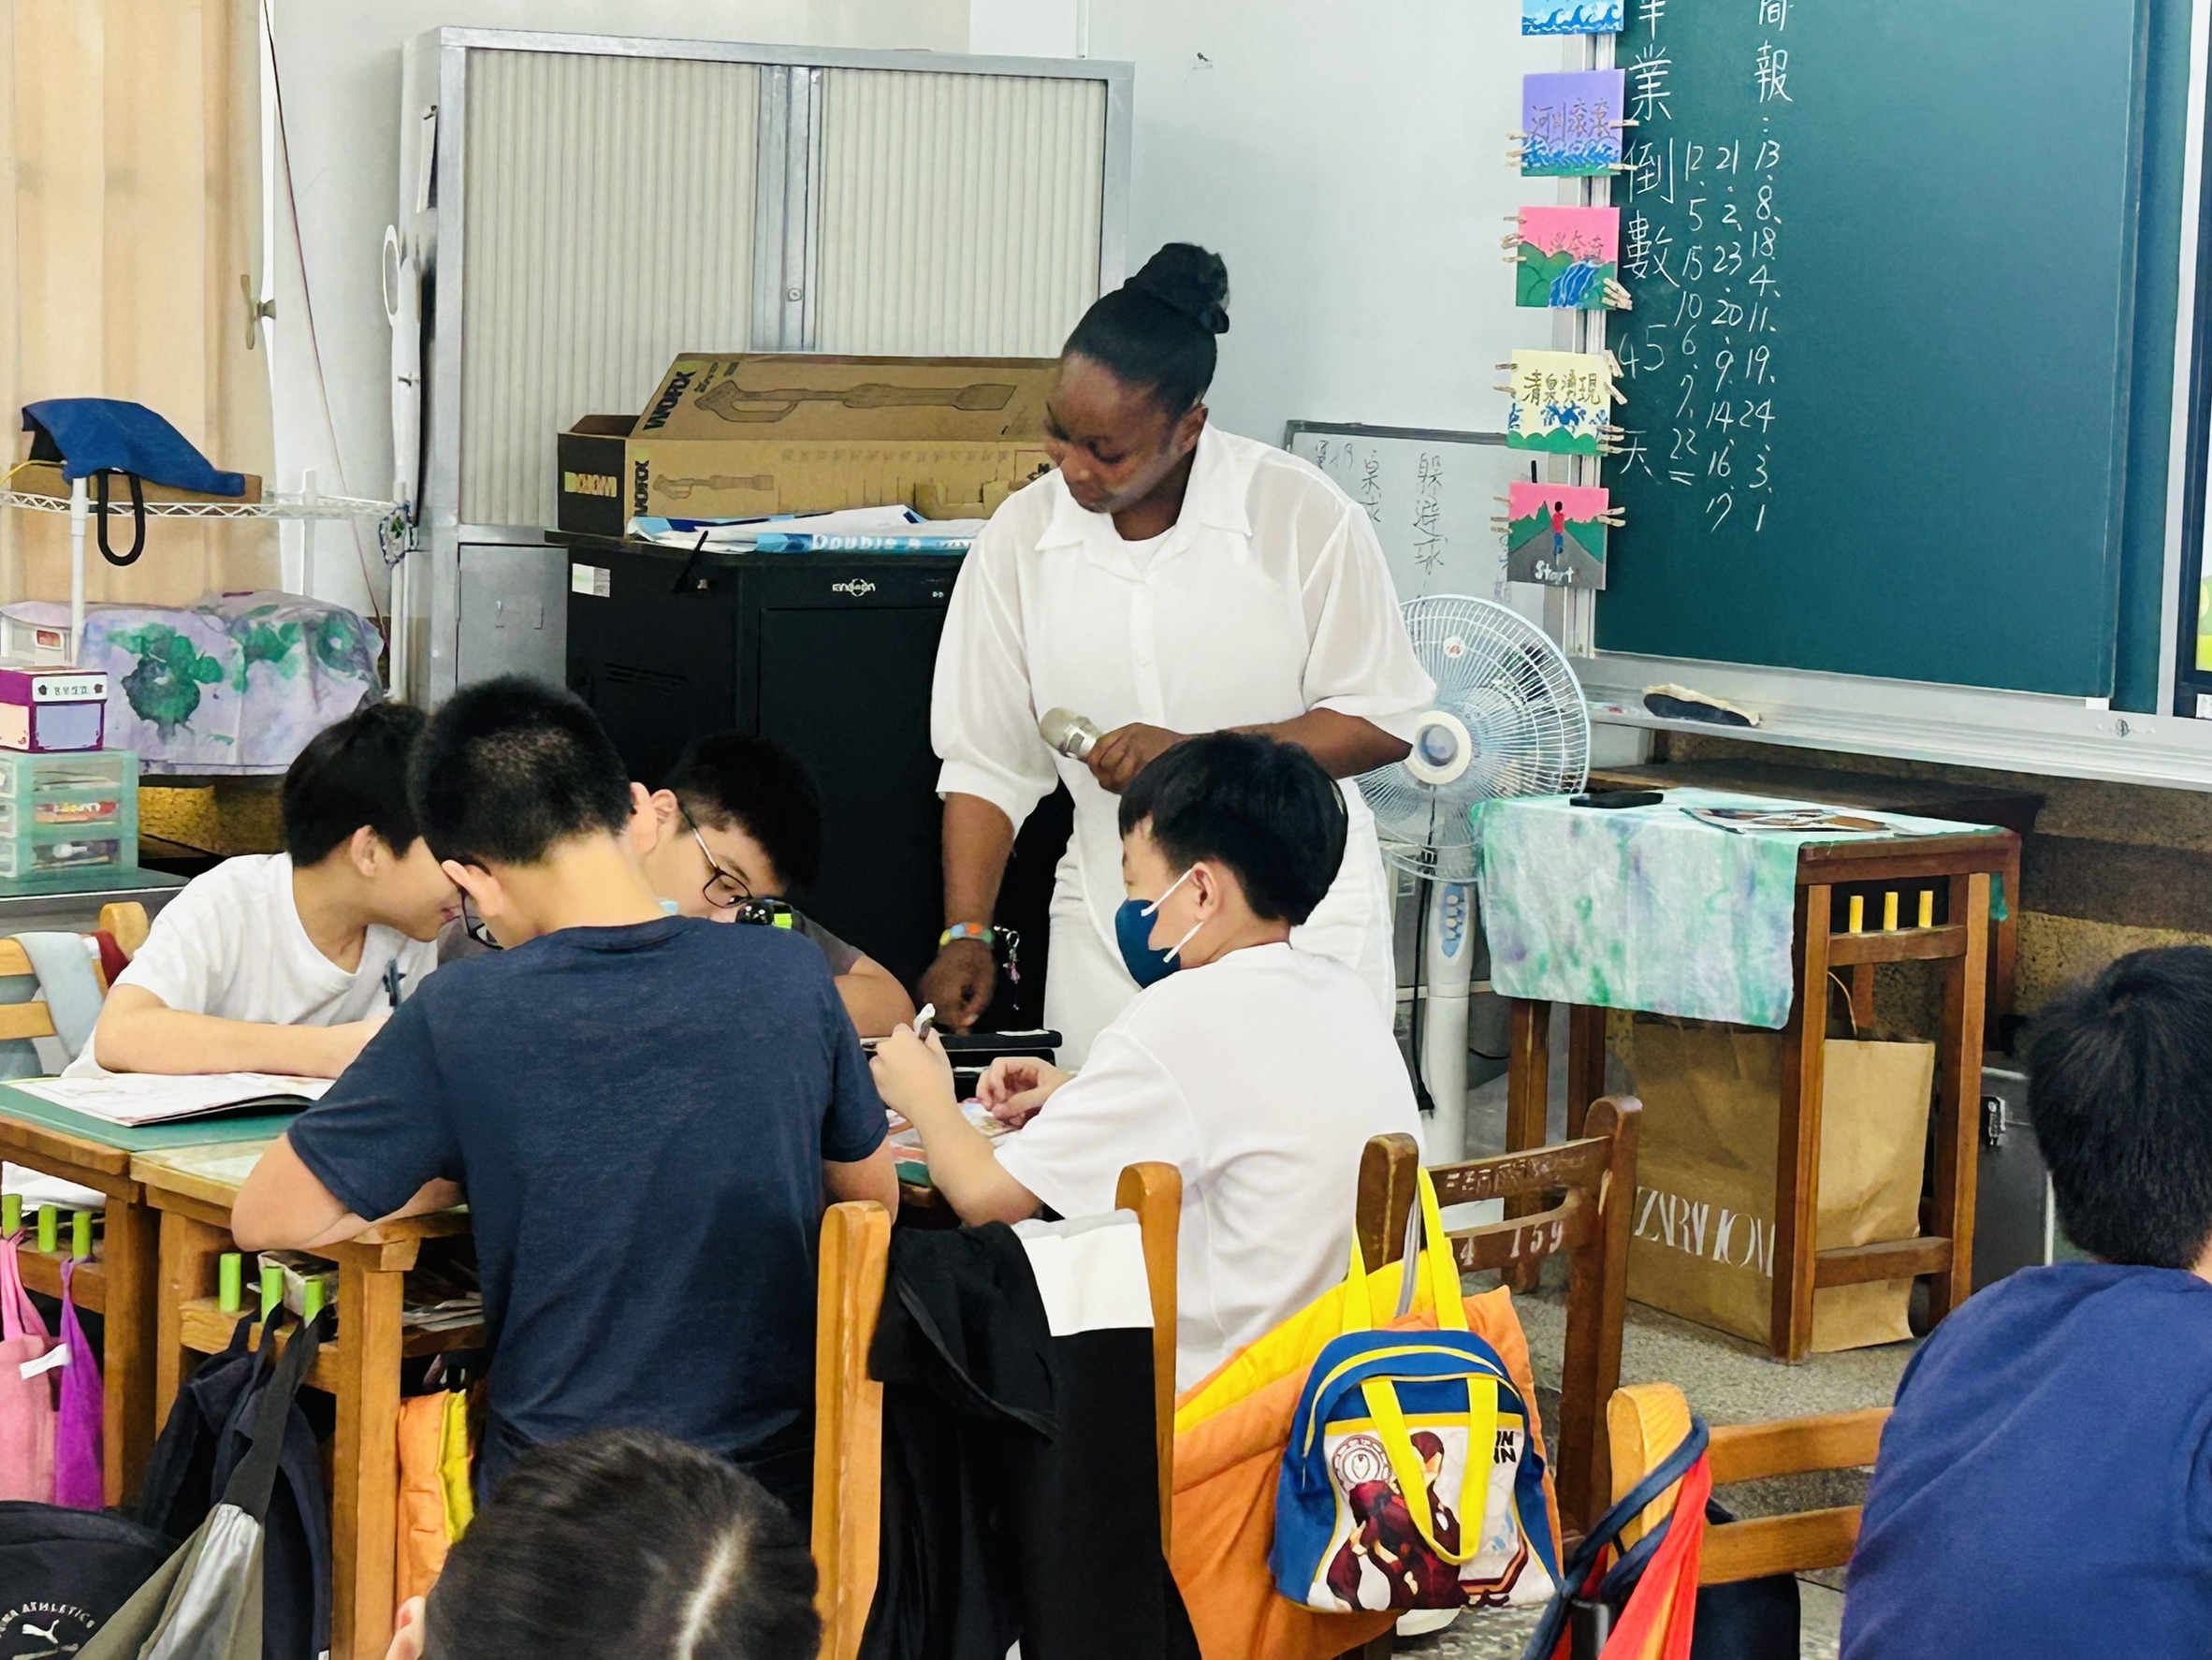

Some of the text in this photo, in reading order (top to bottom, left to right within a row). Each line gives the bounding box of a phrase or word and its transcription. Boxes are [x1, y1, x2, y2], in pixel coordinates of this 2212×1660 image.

[643, 370, 698, 430] WORX
[633, 459, 649, 517] WORX
[812, 534, 897, 550] Double
